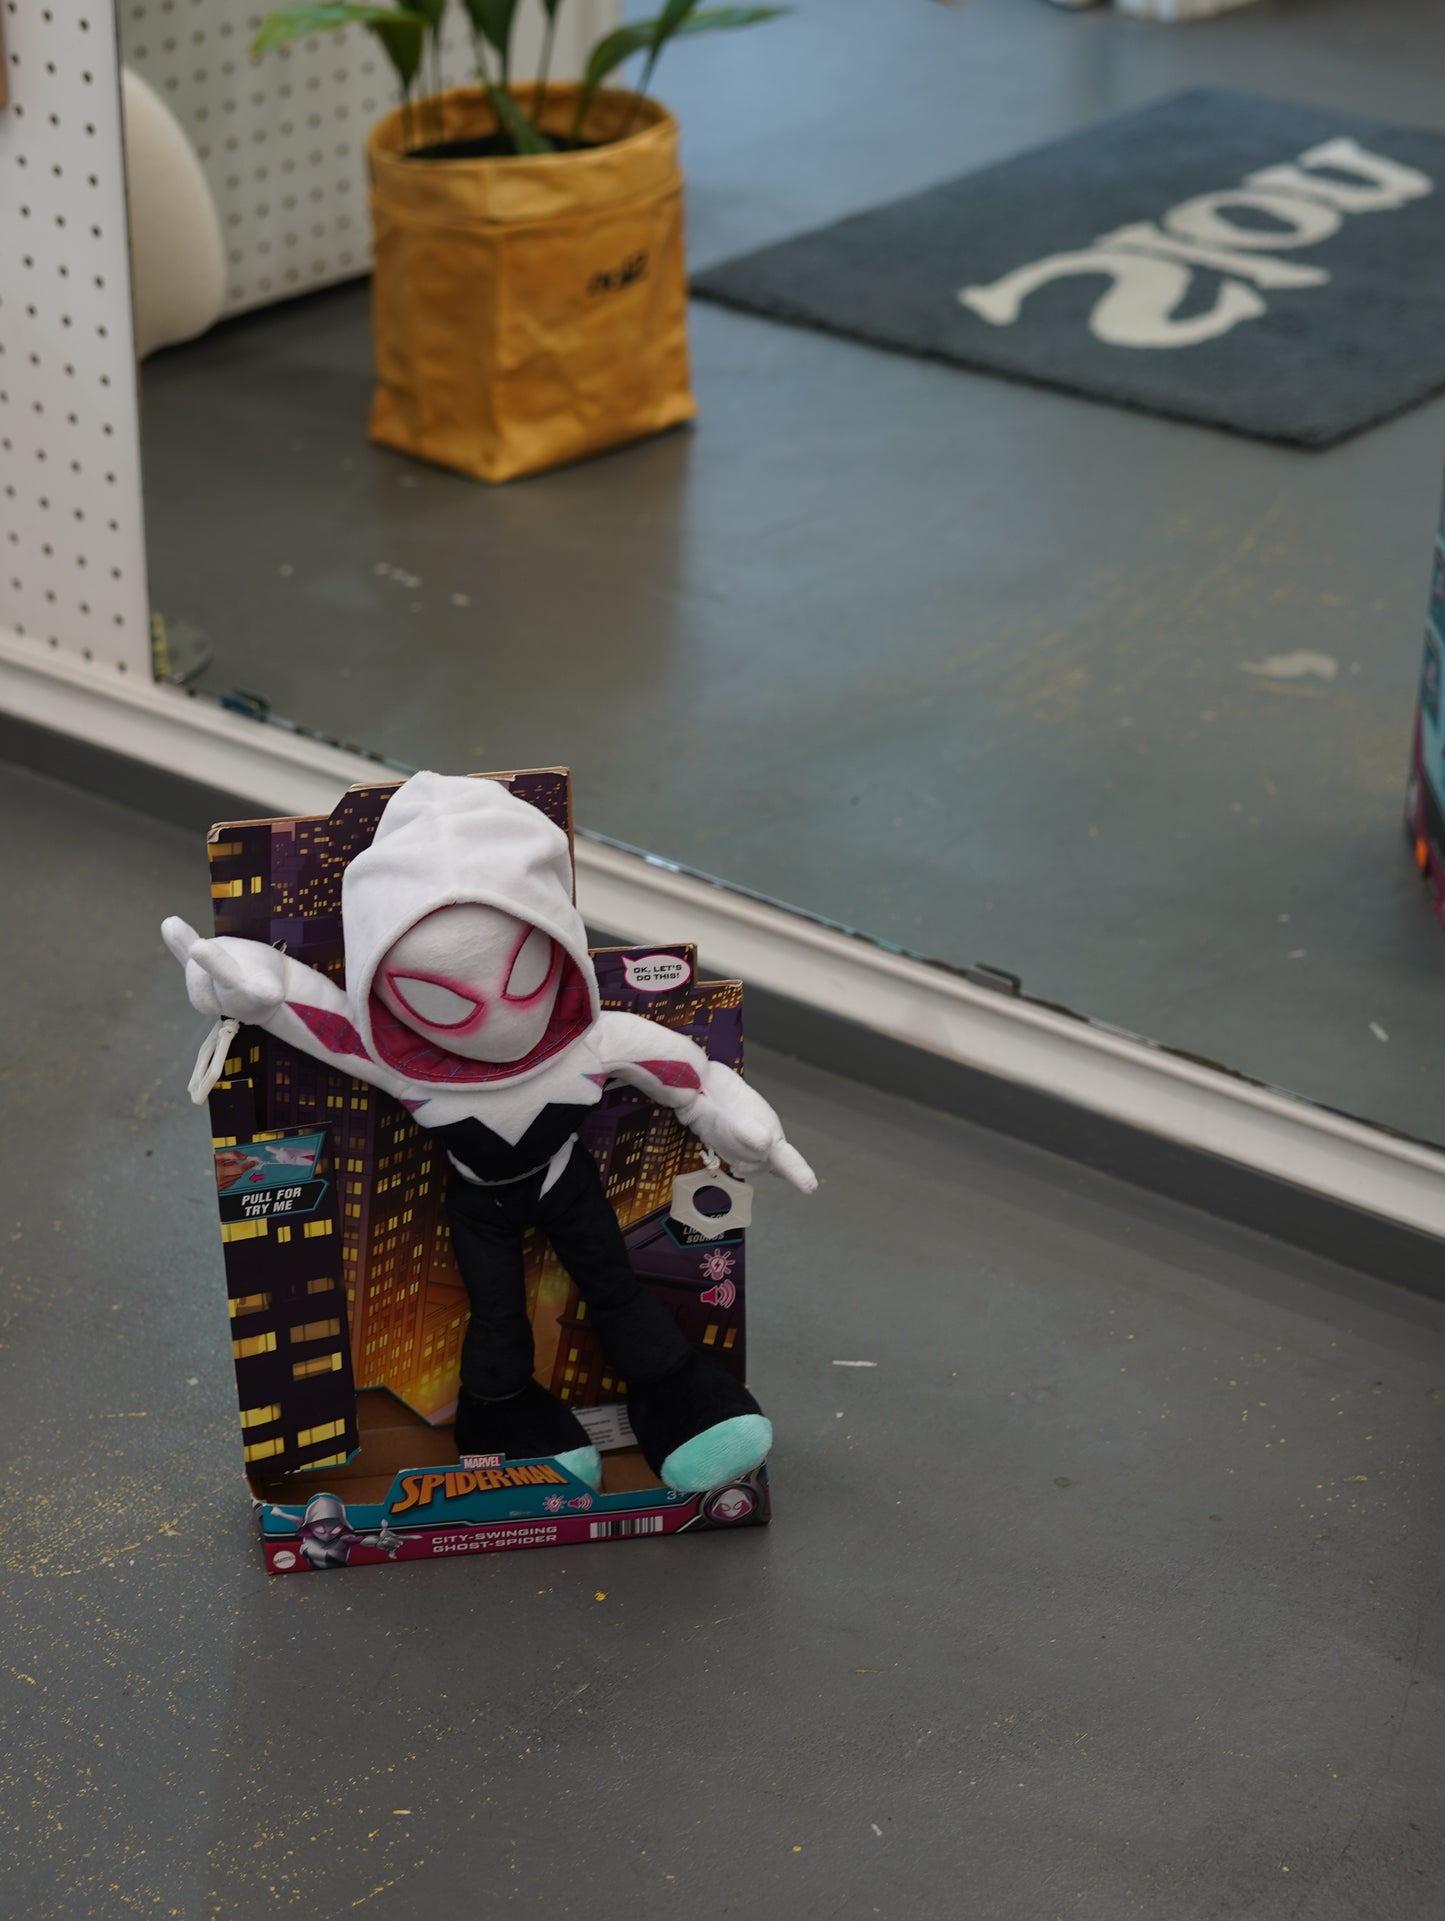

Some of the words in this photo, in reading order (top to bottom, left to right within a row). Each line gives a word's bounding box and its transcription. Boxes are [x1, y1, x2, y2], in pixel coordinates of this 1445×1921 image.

[633, 966, 651, 974] OK,
[653, 964, 682, 973] LET'S
[636, 974, 651, 982] DO
[653, 972, 680, 980] THIS!
[241, 1191, 273, 1206] PULL
[276, 1187, 302, 1200] FOR
[245, 1203, 270, 1217] TRY
[272, 1199, 293, 1213] ME
[463, 1456, 501, 1469] MARVEL
[390, 1463, 569, 1515] SPIDER-MAN
[431, 1525, 558, 1546] CITY-SWINGING
[432, 1534, 558, 1554] GHOST-SPIDER
